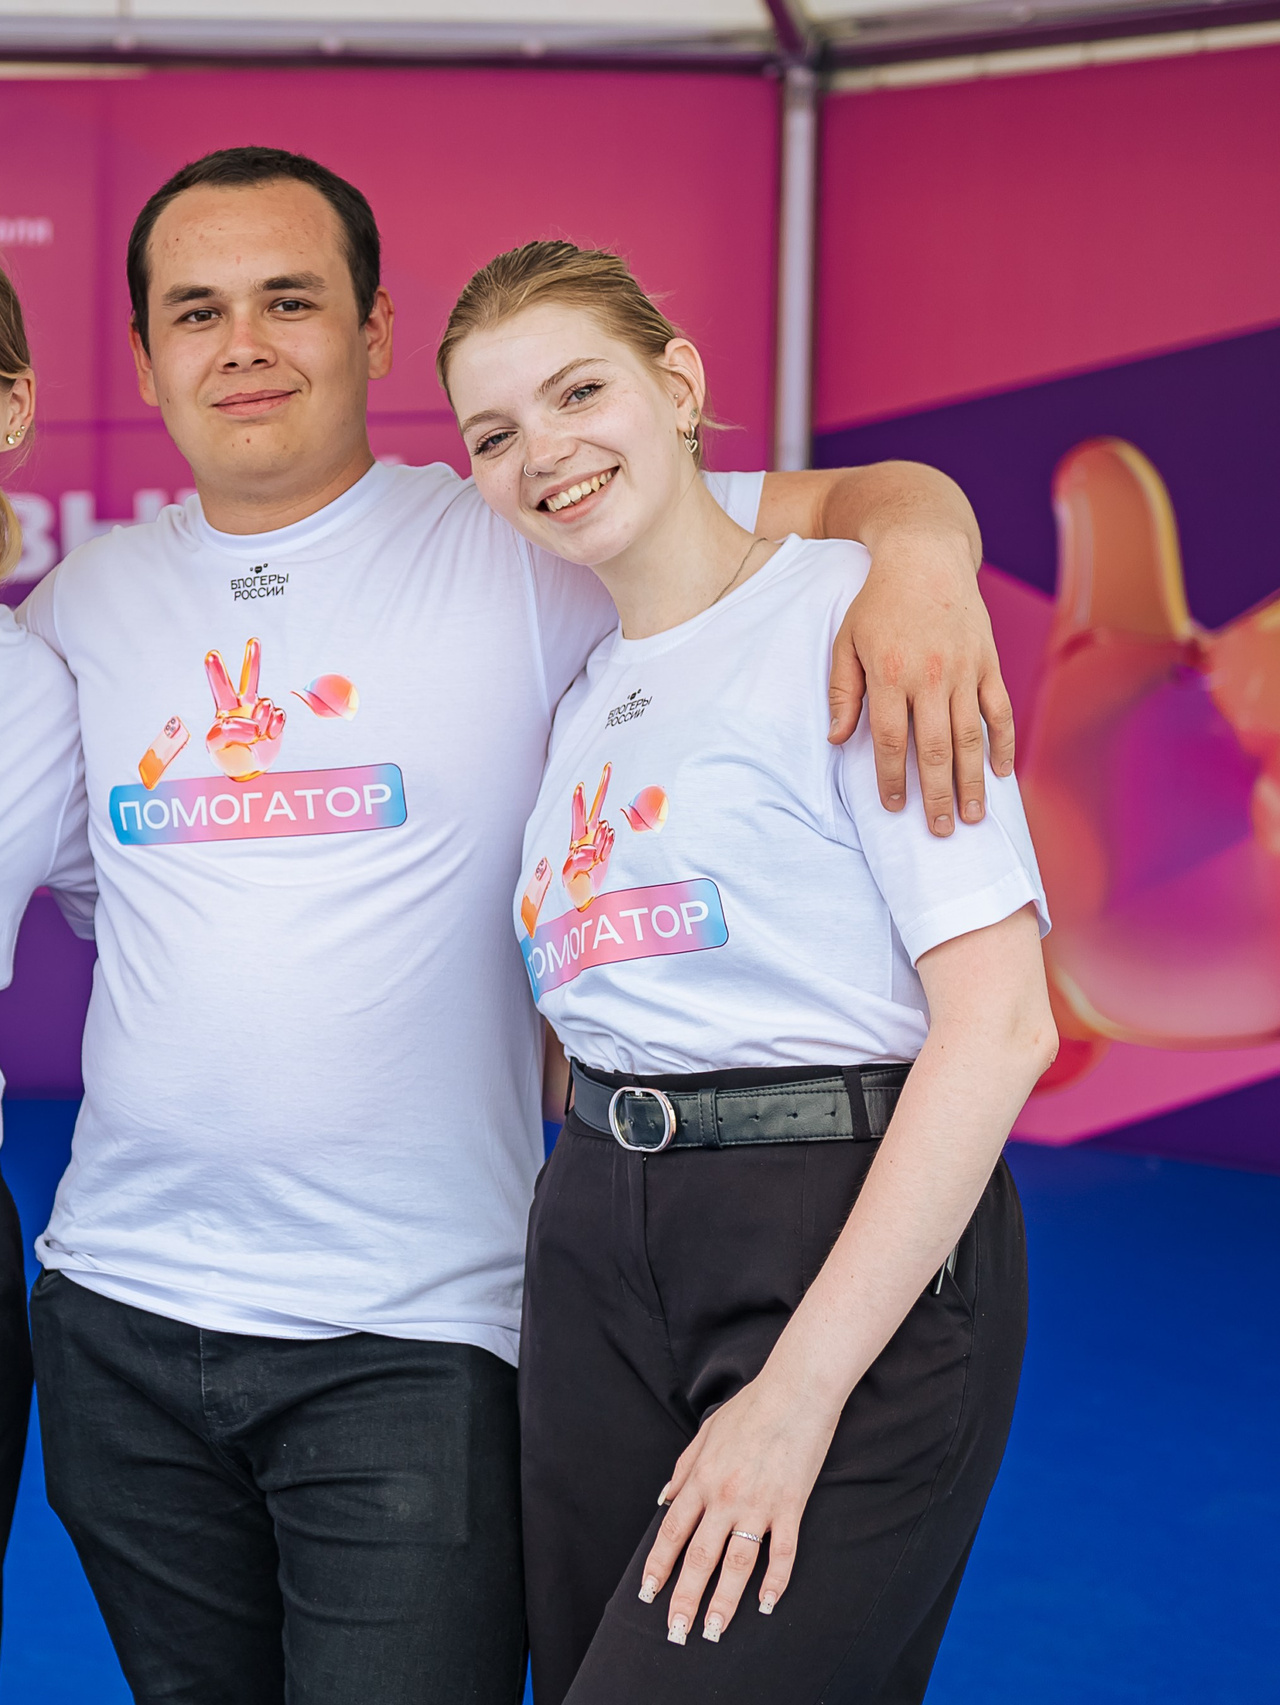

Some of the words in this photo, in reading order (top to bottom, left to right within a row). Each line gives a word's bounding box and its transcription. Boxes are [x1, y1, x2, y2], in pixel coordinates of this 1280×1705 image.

[230, 573, 289, 590] БЛОГЕРЫ
[233, 585, 285, 601] РОССИИ
[604, 707, 646, 729] РОССИИ
[118, 782, 392, 832] ПОМОГАТОР
